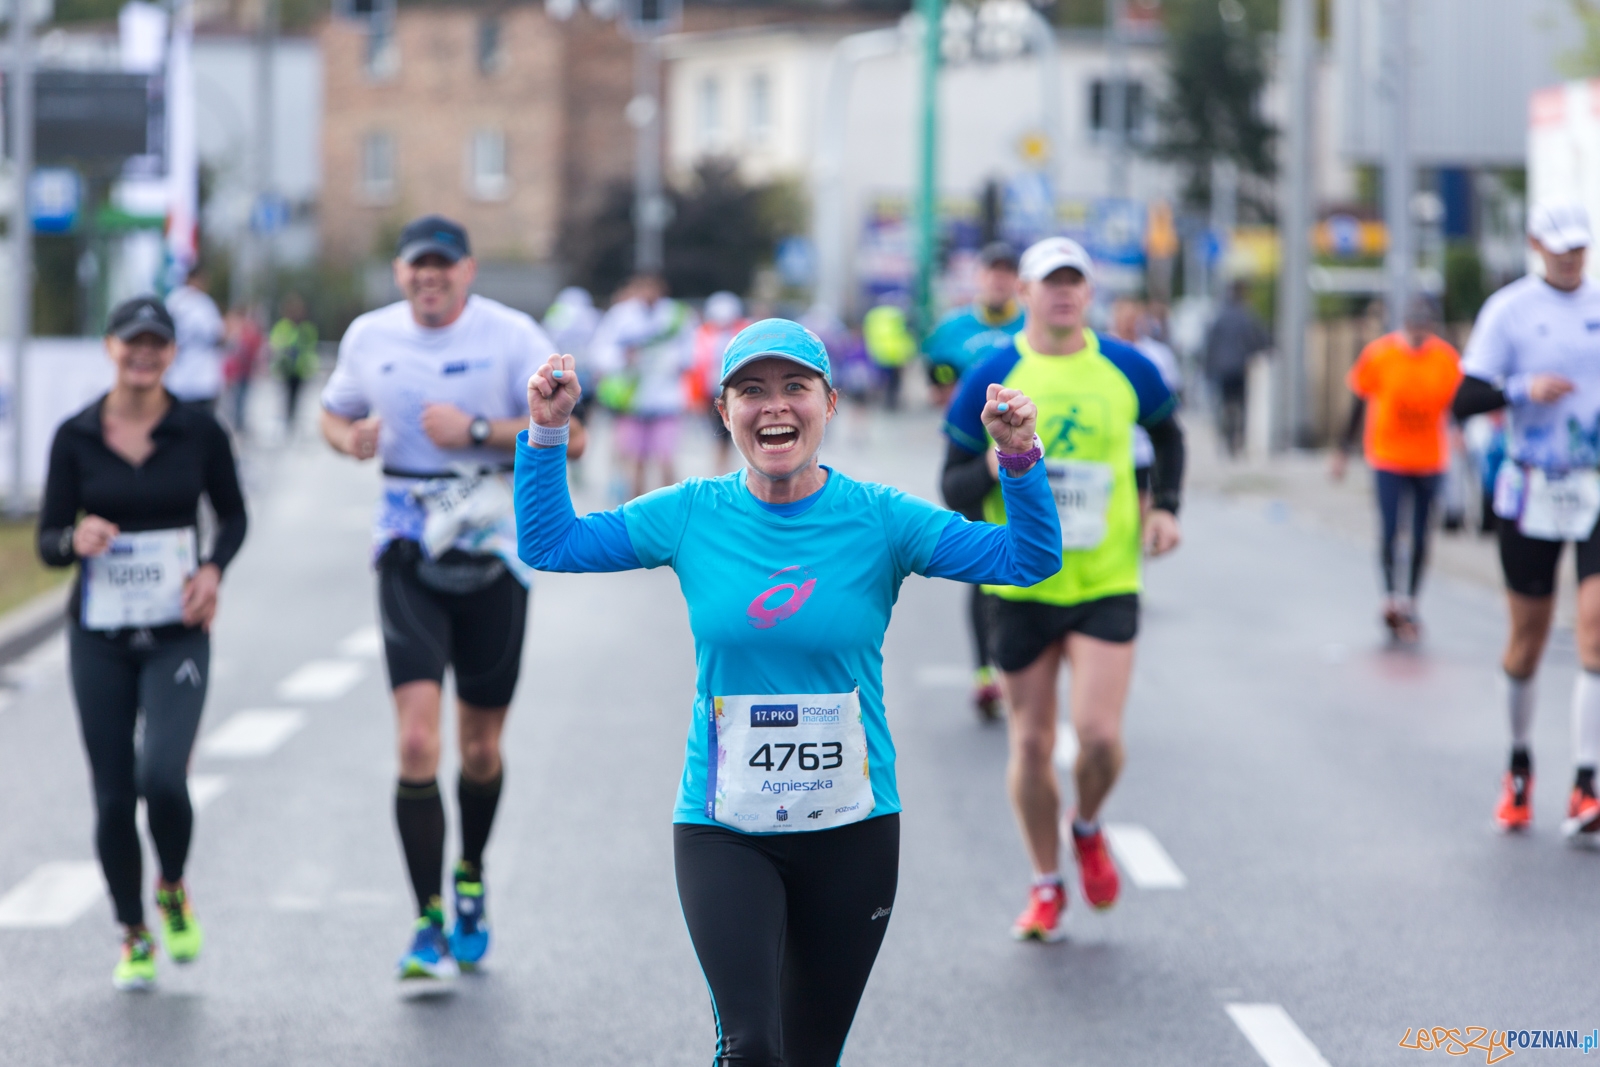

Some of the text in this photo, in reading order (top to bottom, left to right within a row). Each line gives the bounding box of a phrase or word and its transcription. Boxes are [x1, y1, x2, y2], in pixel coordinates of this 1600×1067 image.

[802, 714, 840, 722] maraton
[748, 741, 843, 772] 4763
[761, 779, 833, 794] Agnieszka
